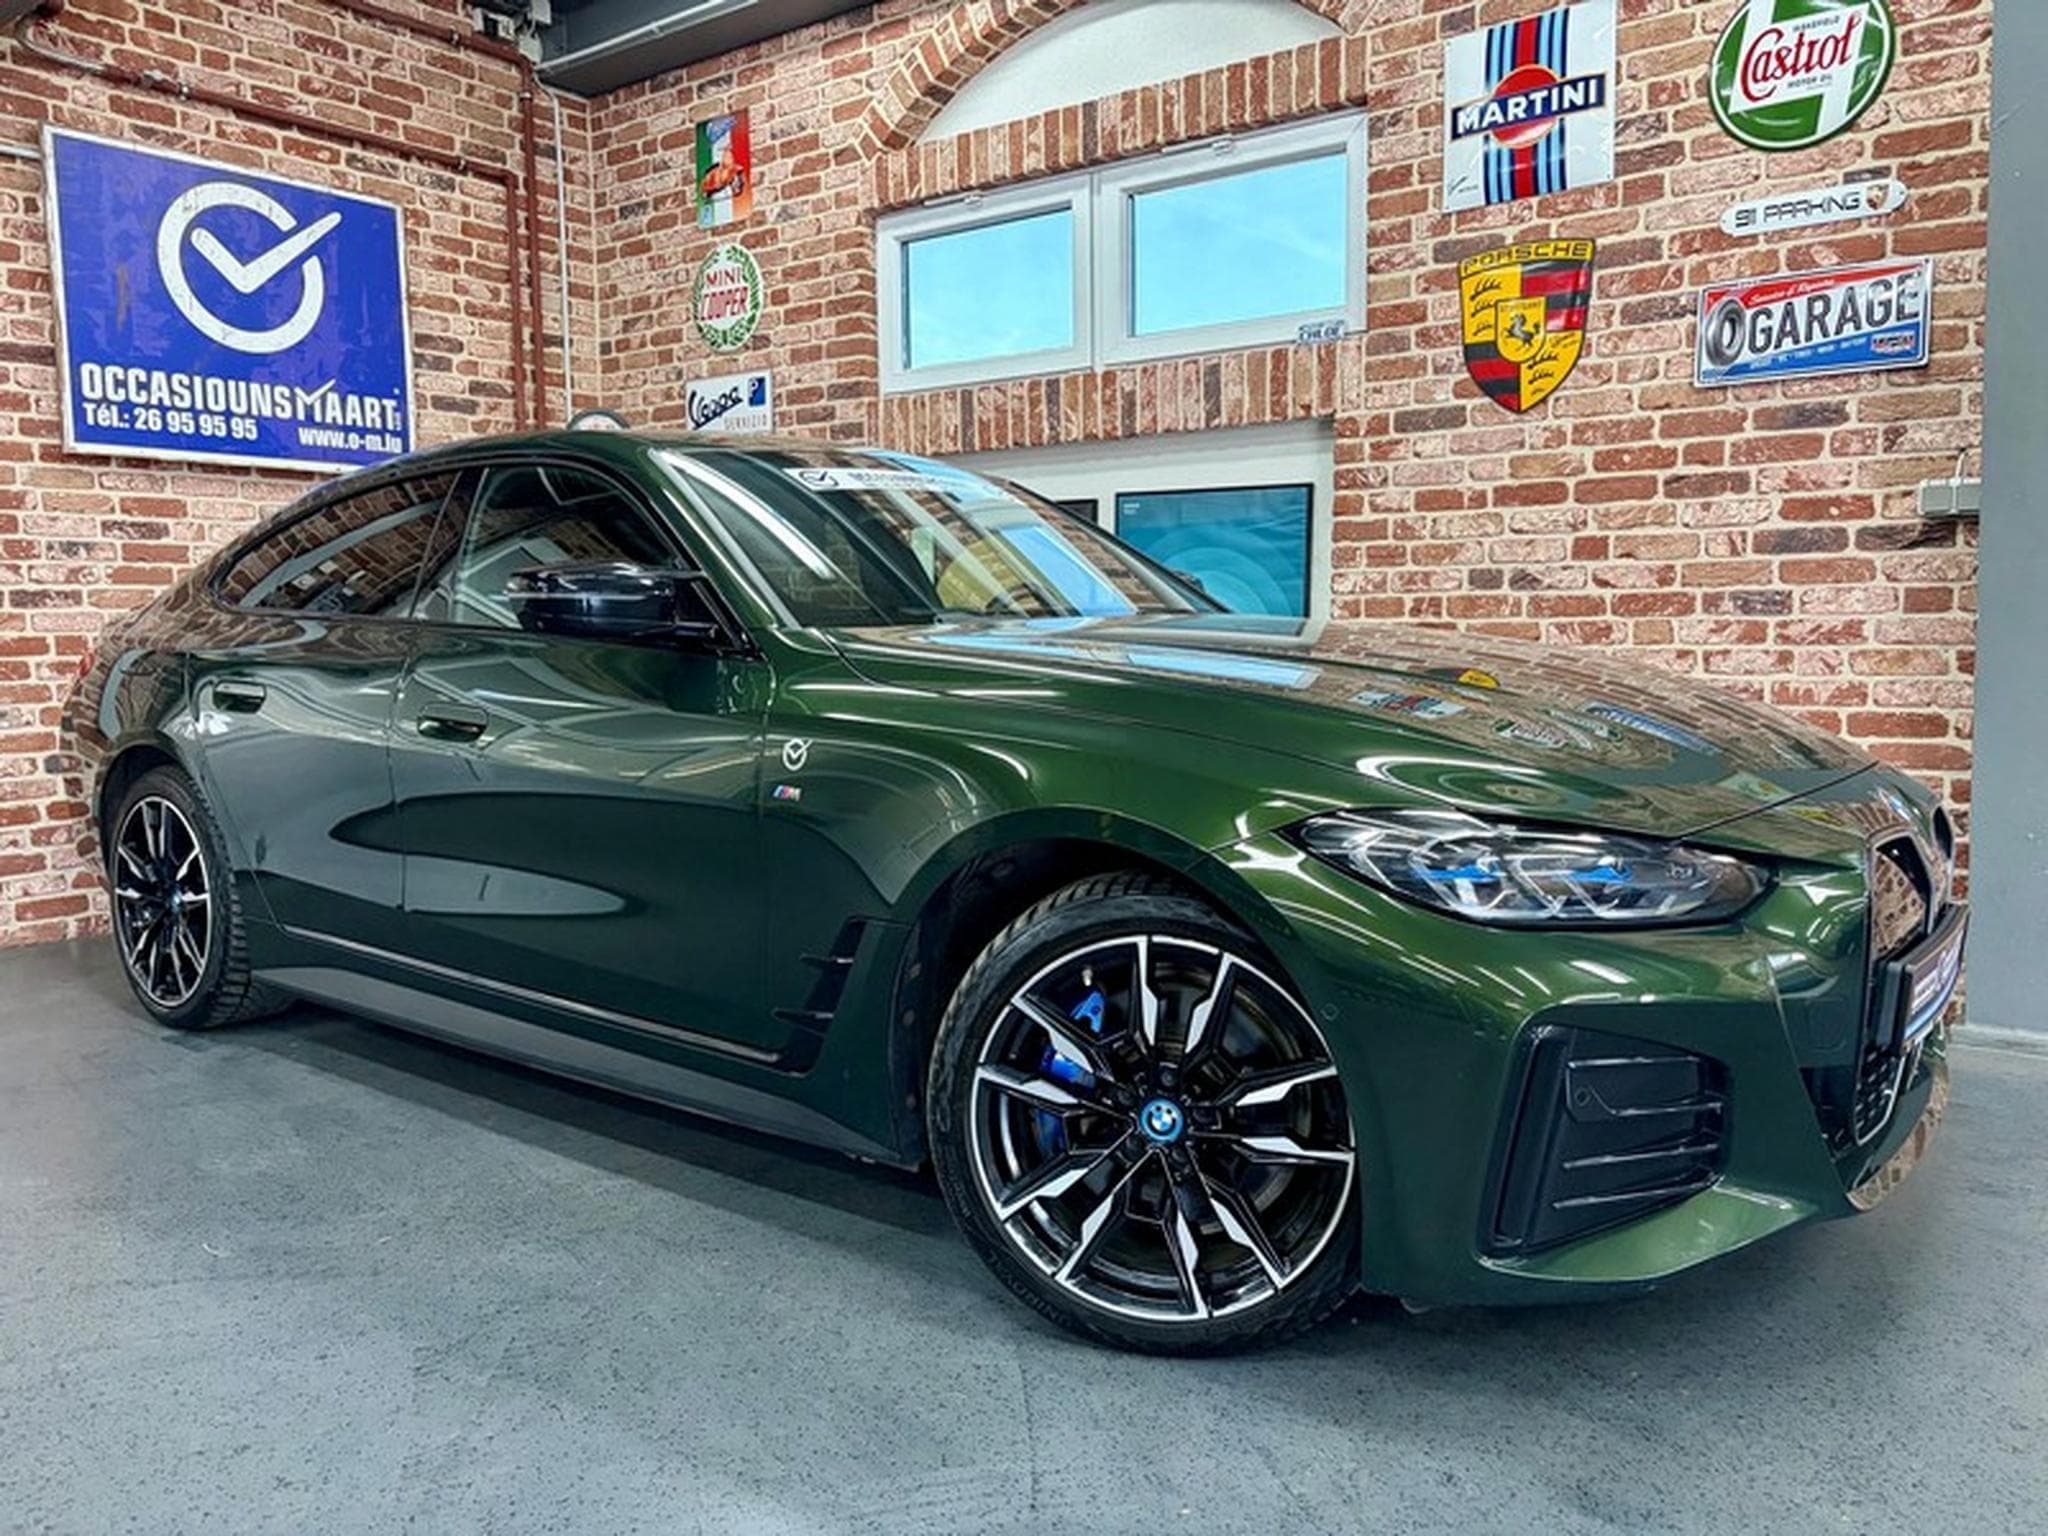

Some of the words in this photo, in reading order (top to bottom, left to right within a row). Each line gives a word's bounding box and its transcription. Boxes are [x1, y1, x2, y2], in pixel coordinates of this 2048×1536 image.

[1740, 11, 1861, 102] Castrol
[1456, 79, 1597, 134] MARTINI
[1463, 242, 1589, 274] PORSCHE
[706, 265, 741, 287] MINI
[701, 286, 749, 321] COOPER
[1748, 270, 1922, 355] GARAGE
[134, 407, 162, 432] 26
[166, 410, 195, 434] 95
[200, 413, 227, 437] 95
[231, 416, 259, 441] 95
